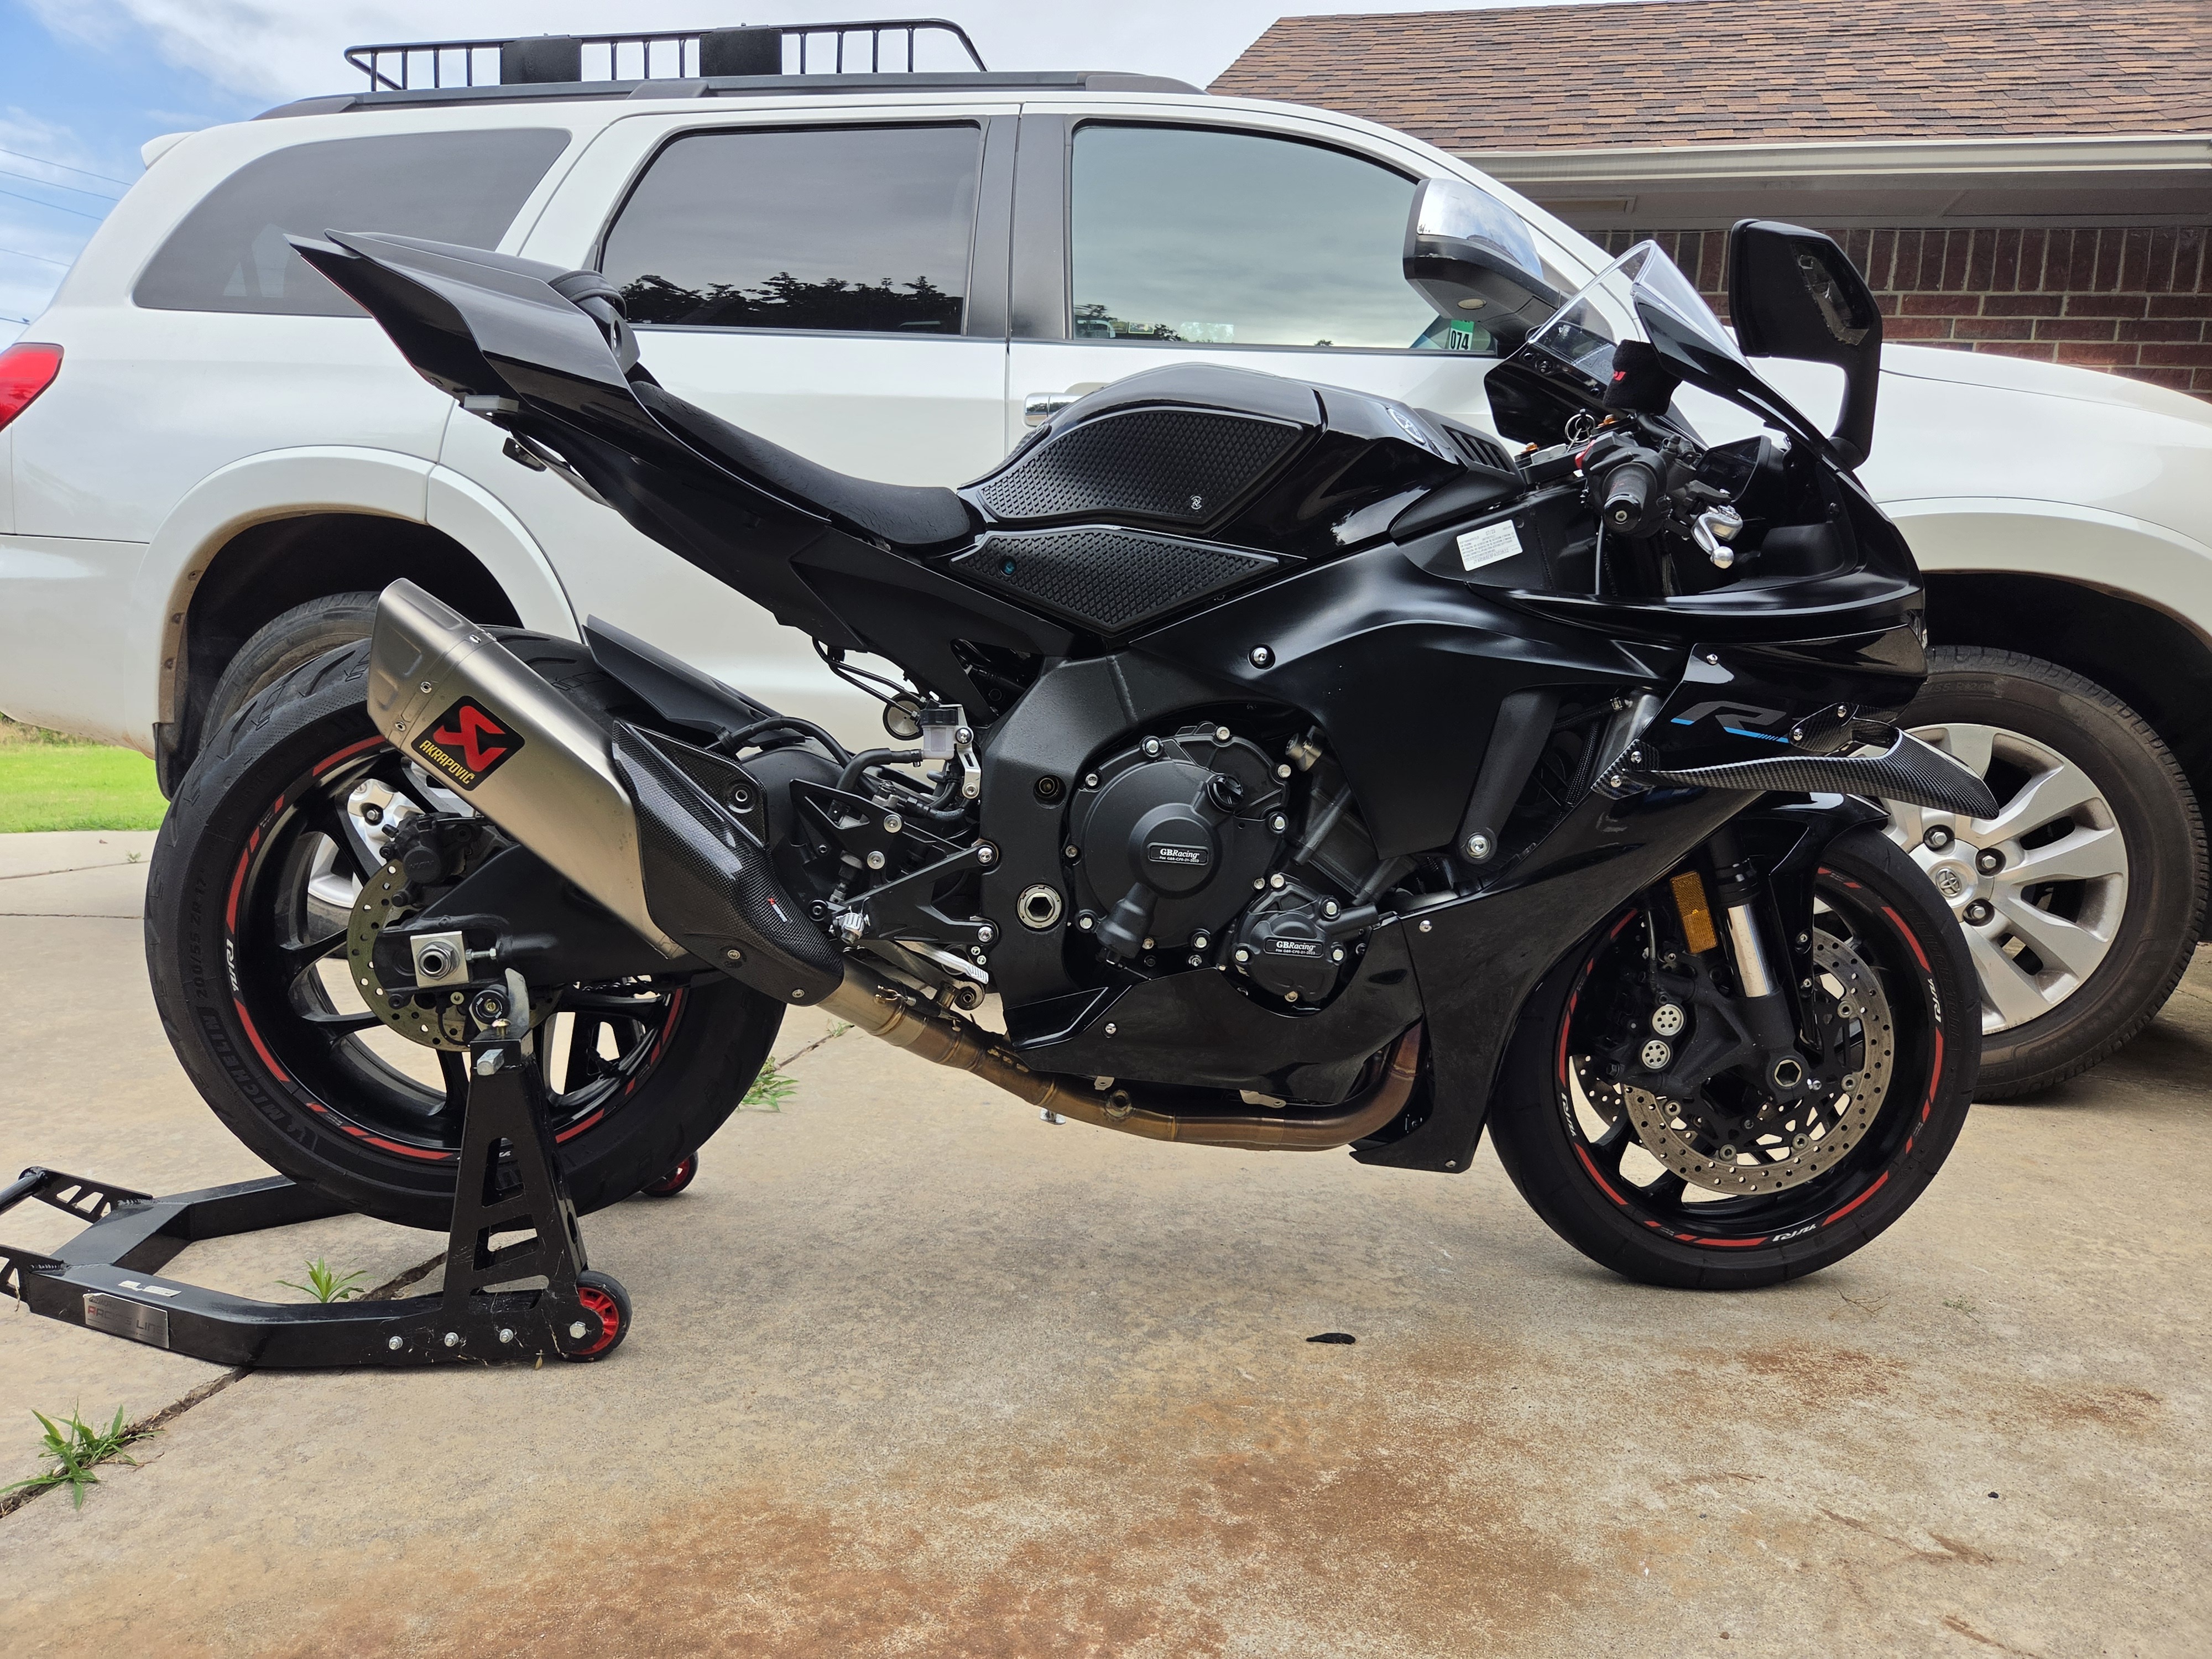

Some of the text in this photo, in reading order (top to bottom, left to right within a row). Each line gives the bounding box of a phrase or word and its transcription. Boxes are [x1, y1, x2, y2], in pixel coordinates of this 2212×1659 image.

[1450, 330, 1470, 351] 074
[1160, 848, 1199, 859] GBRacing
[1276, 941, 1315, 952] GBRacing
[202, 1016, 286, 1121] MICHELIN
